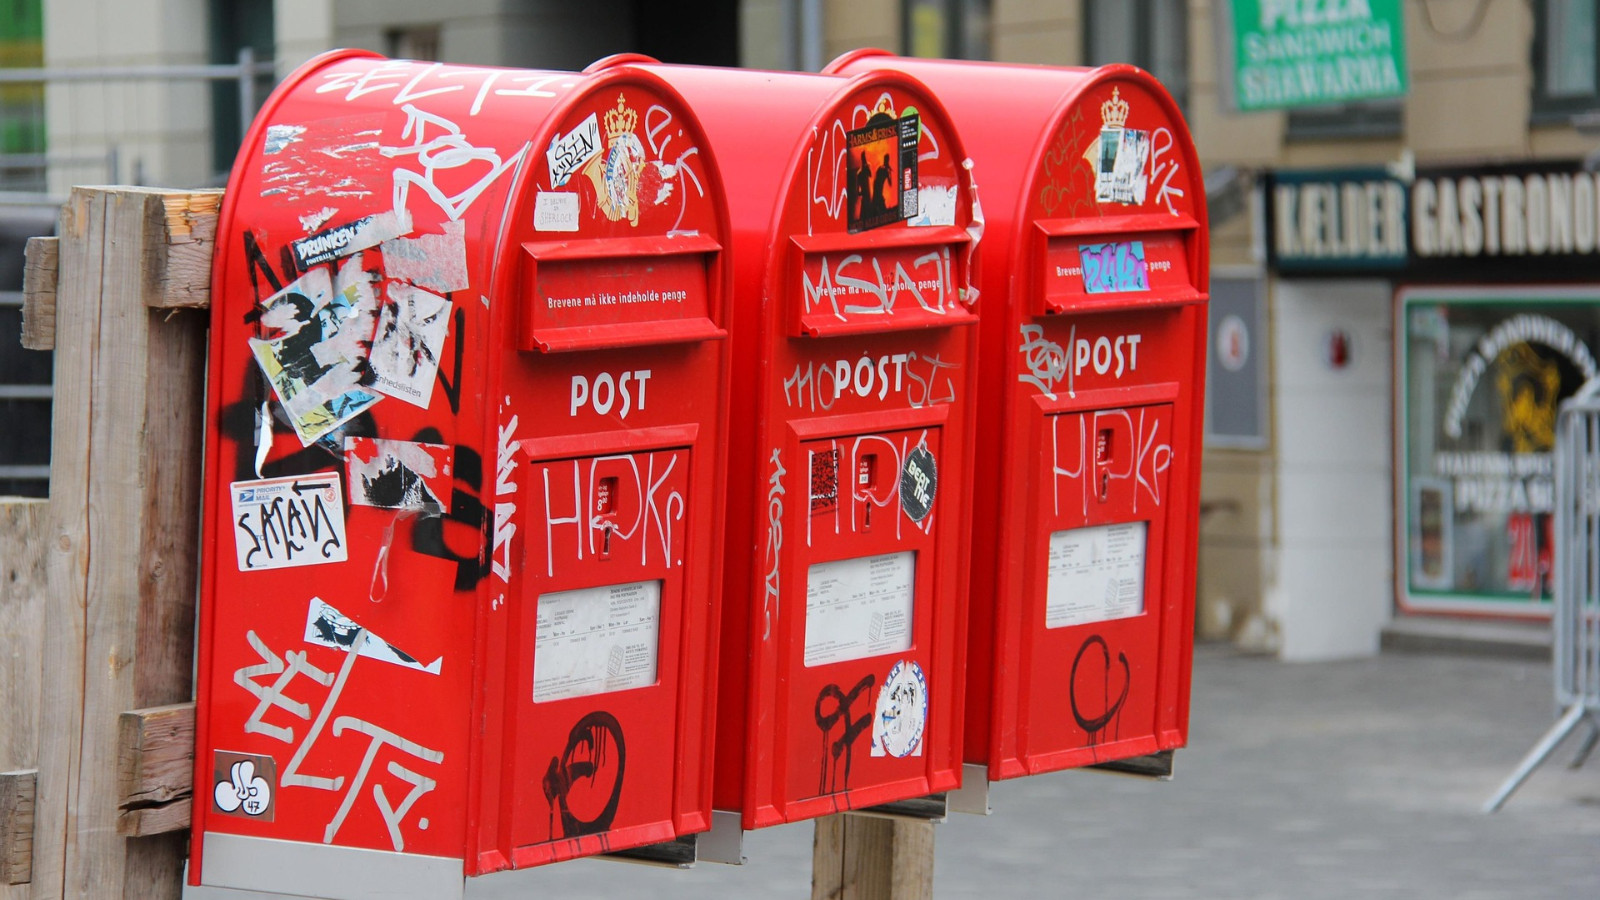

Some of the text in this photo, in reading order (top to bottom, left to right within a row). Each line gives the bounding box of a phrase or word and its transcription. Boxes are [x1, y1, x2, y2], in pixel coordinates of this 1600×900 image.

[1243, 20, 1392, 63] SANDWICH
[1410, 171, 1600, 258] GASTRONO
[1150, 260, 1171, 272] penge
[547, 289, 686, 309] Brevene må ikke indeholde penge
[834, 353, 907, 402] POST
[1075, 334, 1142, 379] POST
[570, 369, 652, 420] POST
[238, 494, 341, 568] SATAN
